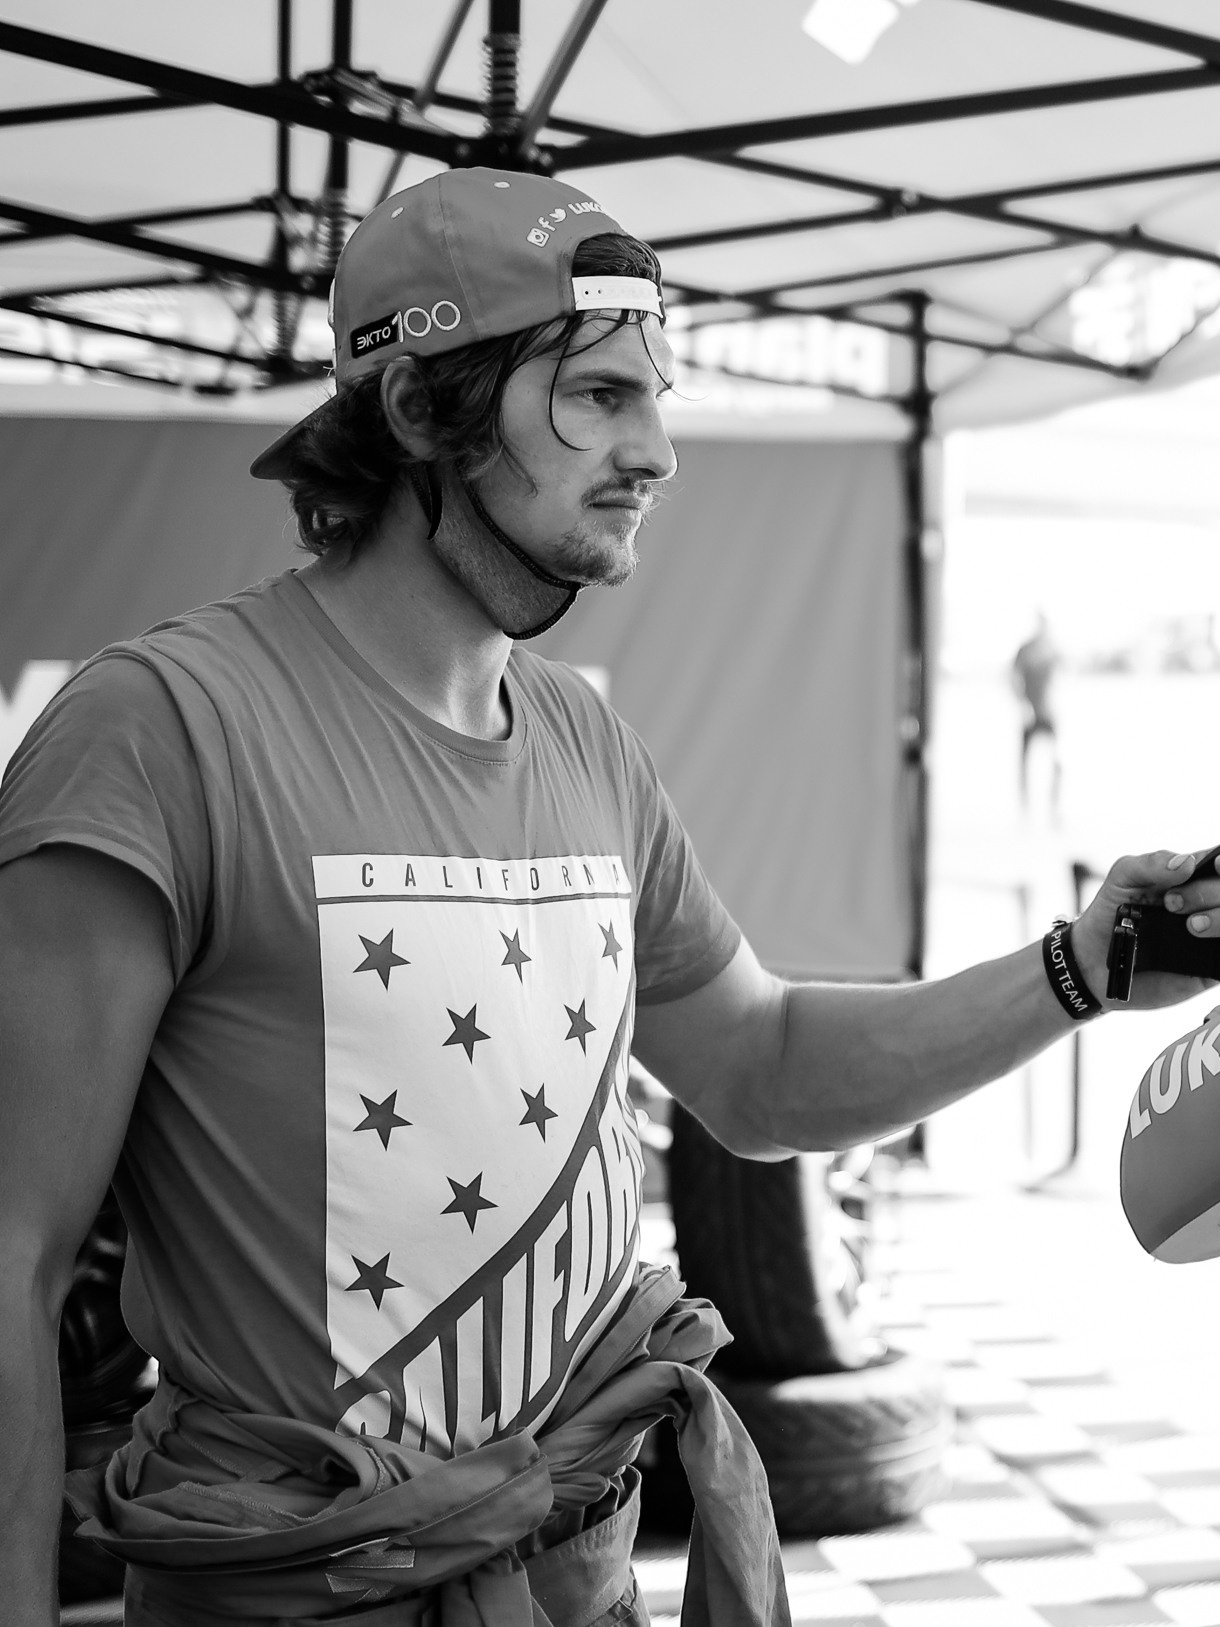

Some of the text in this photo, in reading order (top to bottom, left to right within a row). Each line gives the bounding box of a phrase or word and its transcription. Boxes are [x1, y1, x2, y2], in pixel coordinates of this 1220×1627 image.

[356, 326, 392, 350] ЭКТО
[391, 300, 461, 343] 100
[1051, 930, 1089, 1012] PILOT TEAM
